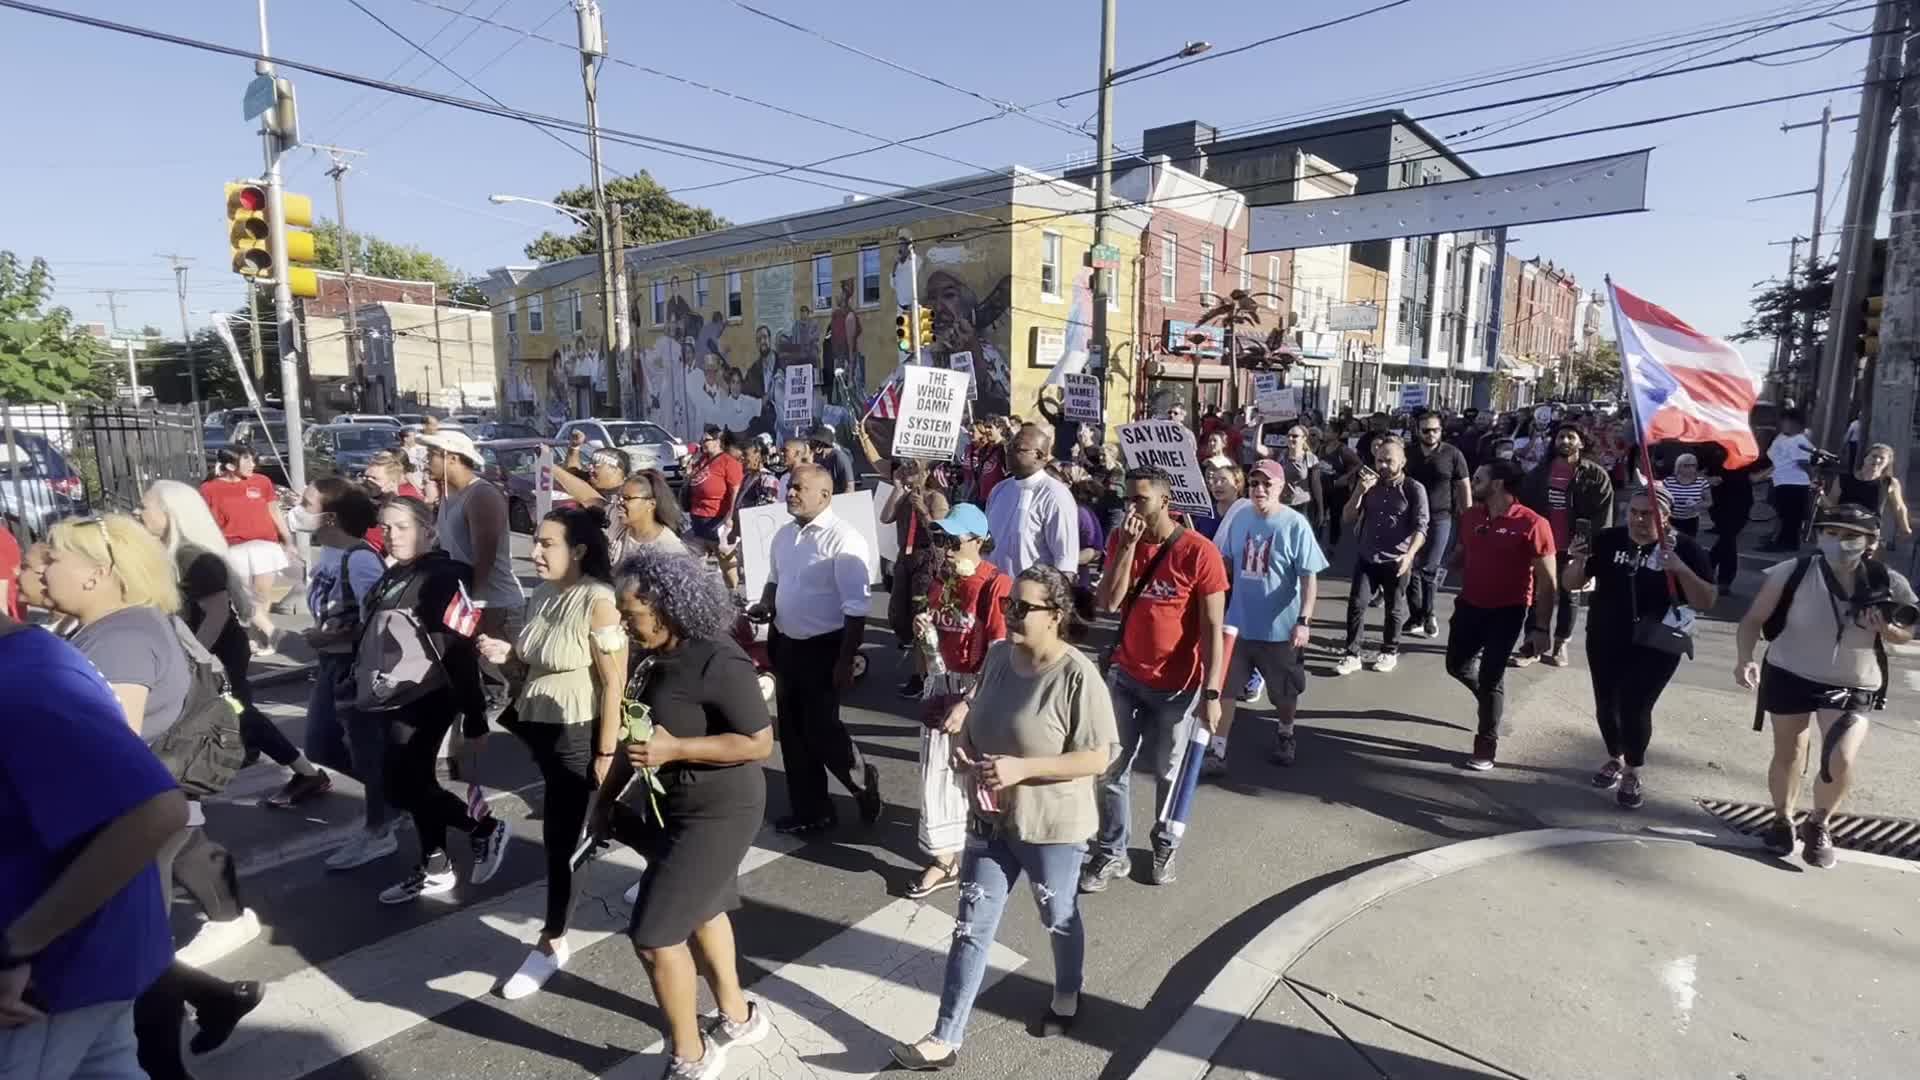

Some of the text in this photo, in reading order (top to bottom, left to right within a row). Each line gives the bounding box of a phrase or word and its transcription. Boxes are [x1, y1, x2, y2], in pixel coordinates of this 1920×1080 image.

[929, 371, 948, 386] THE
[917, 384, 955, 400] WHOLE
[916, 398, 950, 413] DAMN
[907, 416, 952, 433] SYSTEM
[899, 432, 955, 449] IS GUILTY!
[1122, 425, 1183, 444] SAY HIS
[1135, 449, 1186, 467] NAME!
[1168, 473, 1188, 488] DIE
[1170, 490, 1208, 505] ARRY!
